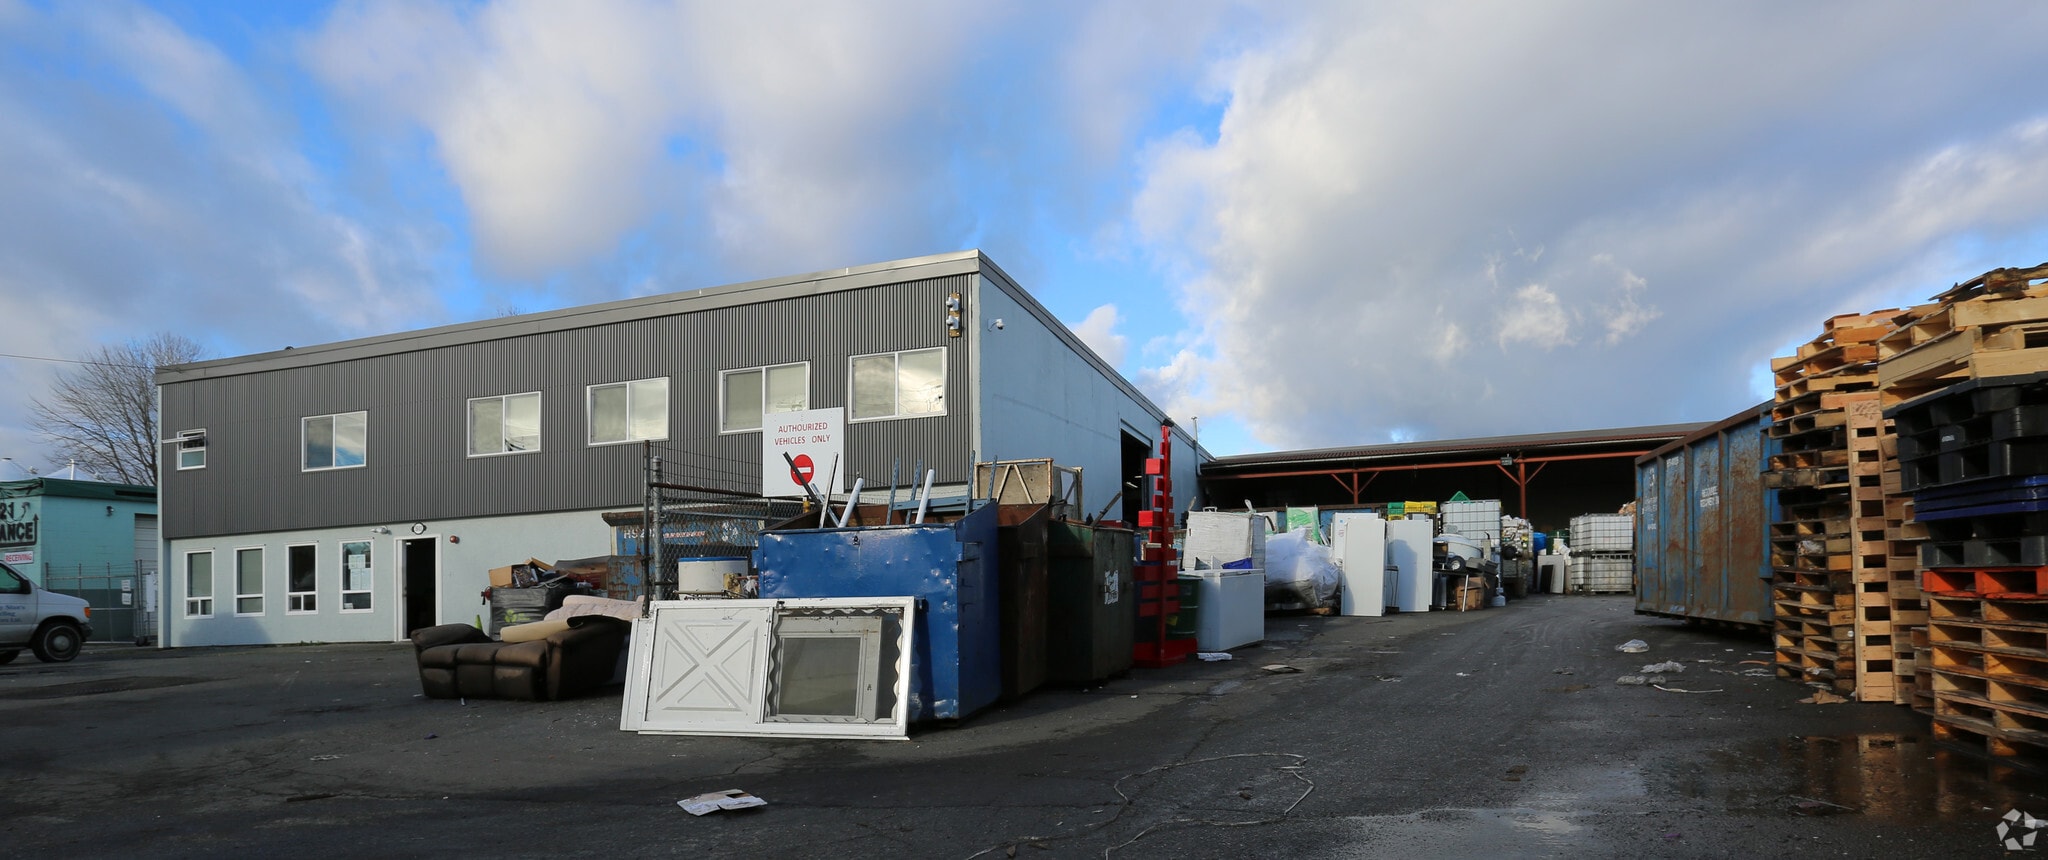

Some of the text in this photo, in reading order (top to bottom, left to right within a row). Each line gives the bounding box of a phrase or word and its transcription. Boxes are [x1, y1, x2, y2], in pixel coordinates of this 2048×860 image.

[778, 422, 827, 433] AUTHOURIZED
[774, 434, 830, 445] VEHICLES ONLY
[5, 554, 32, 562] RECEIVING
